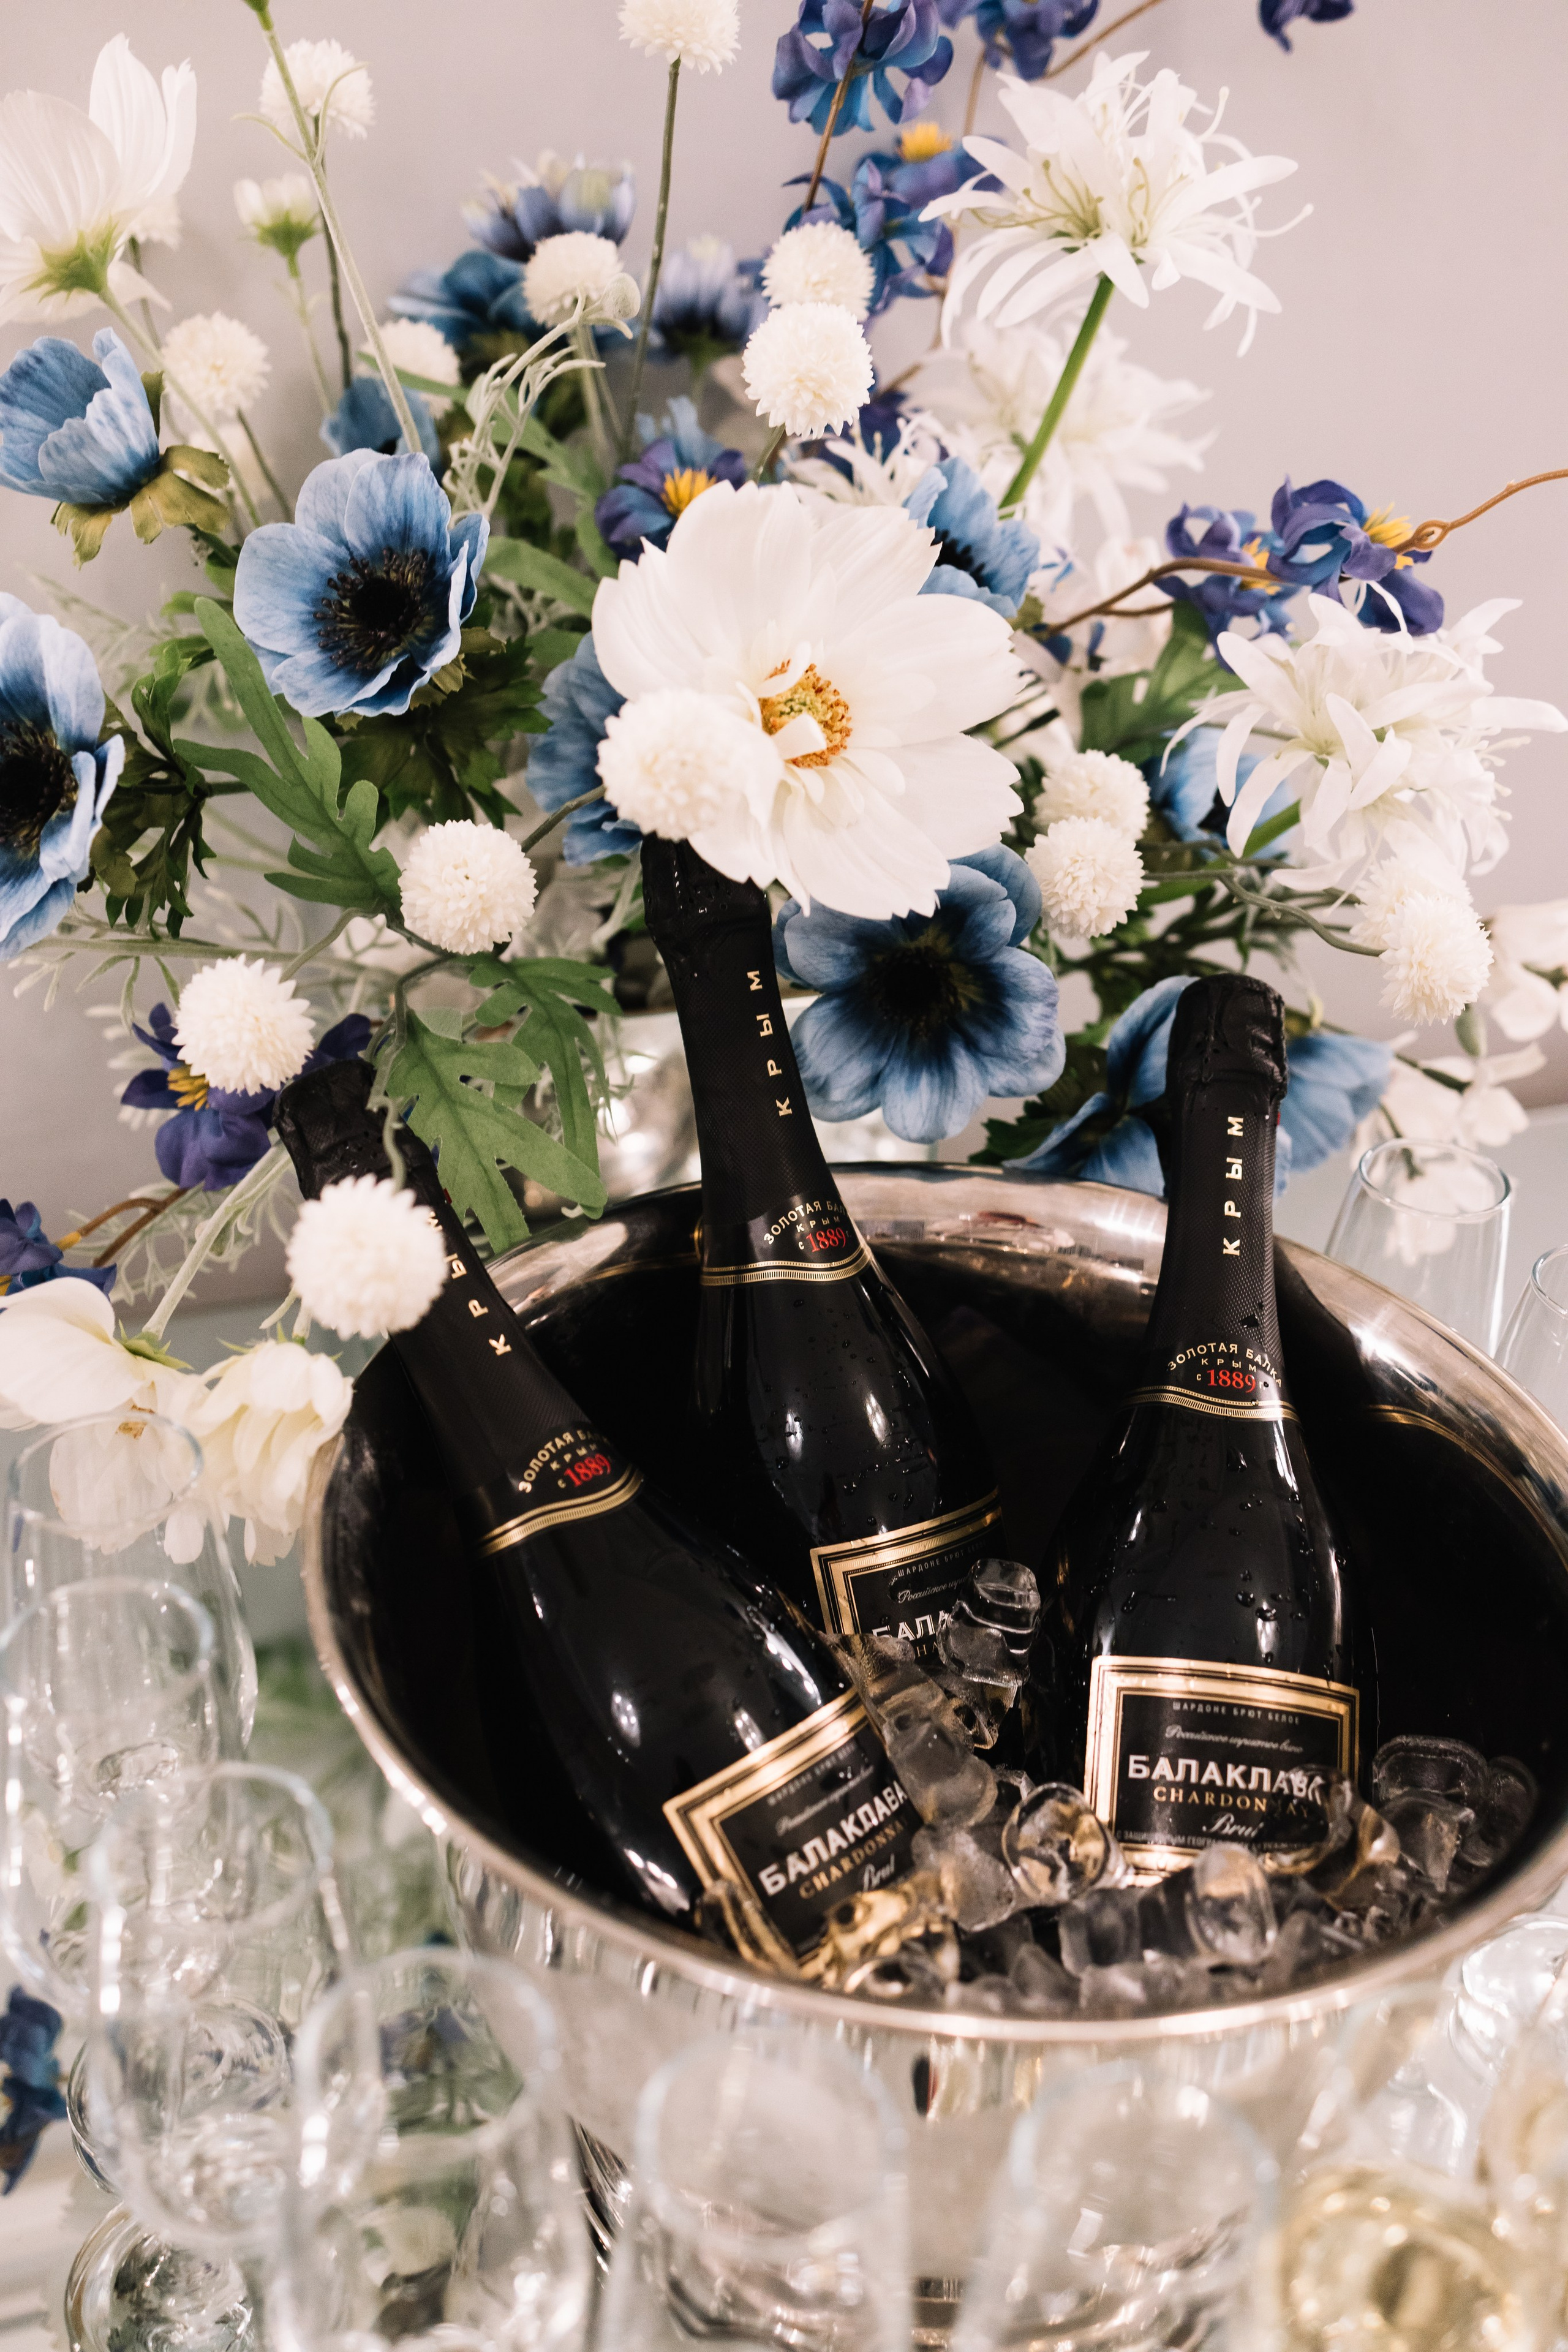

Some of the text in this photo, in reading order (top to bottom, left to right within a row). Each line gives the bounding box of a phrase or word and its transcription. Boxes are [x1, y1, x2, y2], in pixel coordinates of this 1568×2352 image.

[747, 970, 793, 1117] КРЫМ
[1223, 1116, 1244, 1256] КРЫМ
[763, 1200, 850, 1245] ЗОЛОТАЯ БАЛ
[796, 1215, 840, 1233] КРЫМ
[805, 1227, 846, 1253] 1889
[1167, 1342, 1283, 1389] ЗОЛОТАЯ БАЛКА
[1200, 1357, 1257, 1373] КРЫМ
[1206, 1369, 1256, 1394] 1889
[518, 1431, 575, 1494] ЗОЛОТАЯ
[564, 1453, 611, 1487] 1889
[897, 1558, 940, 1577] ШАРДОНЕ
[944, 1550, 965, 1562] БРЮТ
[1172, 1701, 1227, 1716] ШАРДОНЕ
[1232, 1706, 1262, 1719] БРЮТ
[1153, 1786, 1310, 1818] CHARDONAY
[758, 1780, 910, 1896] БАЛАКЛАВА
